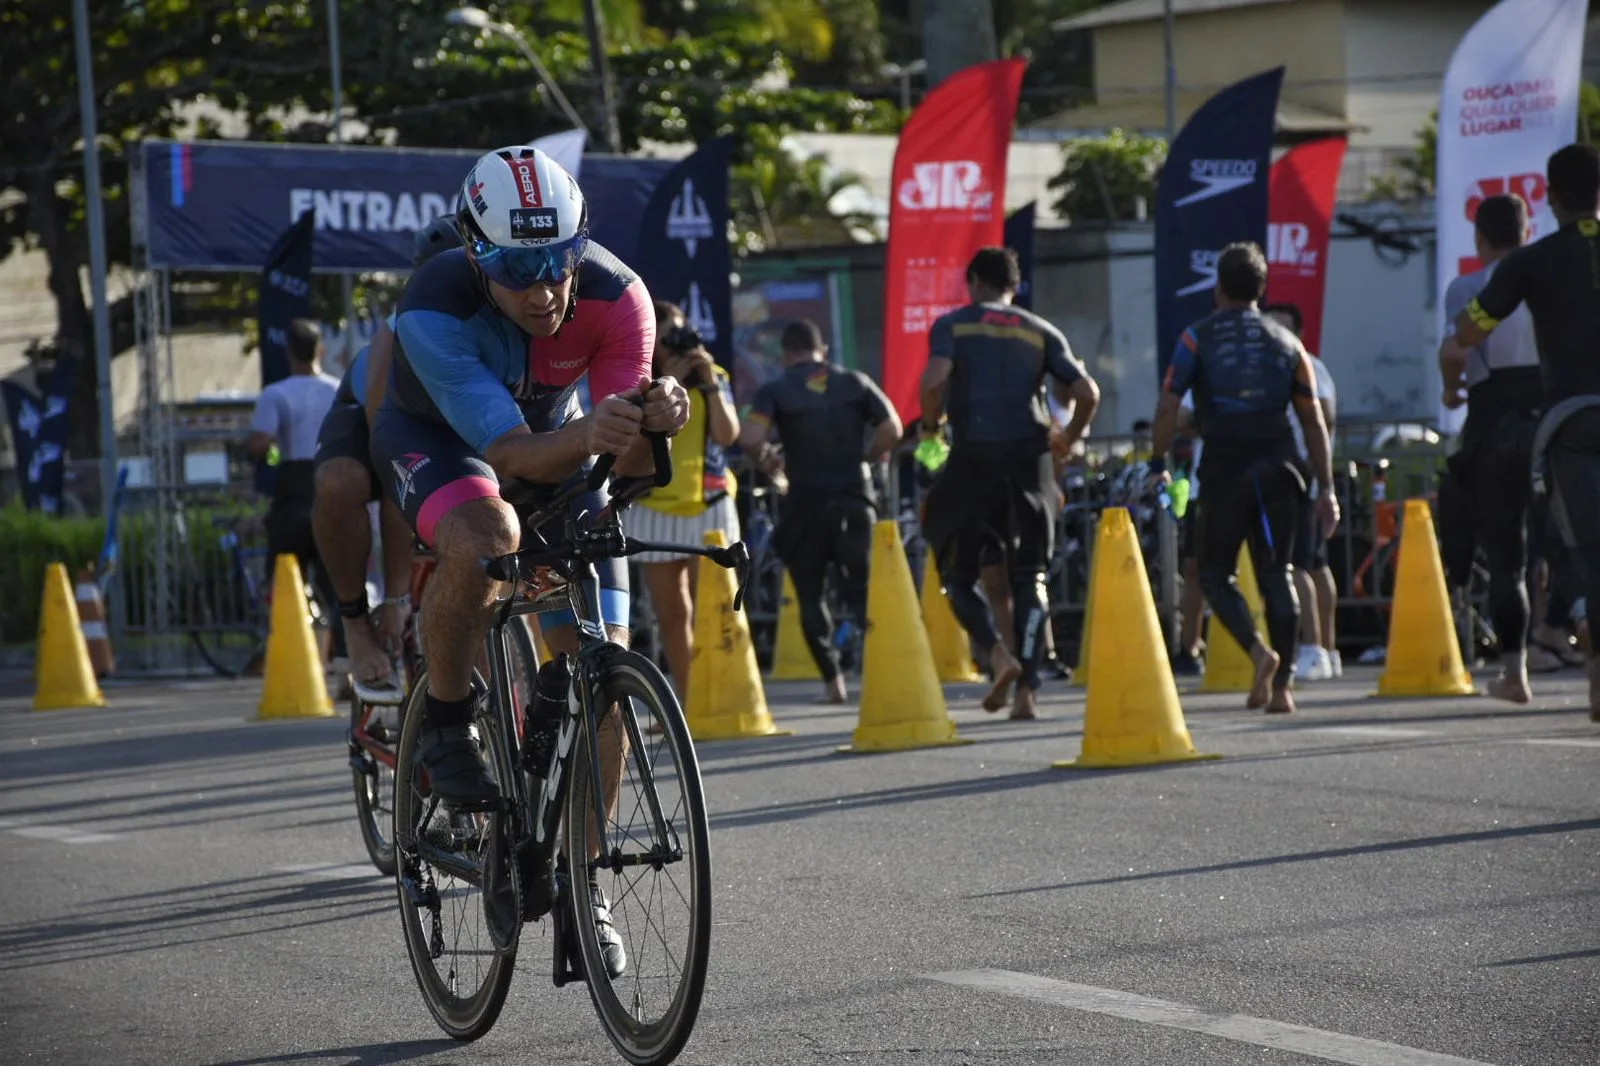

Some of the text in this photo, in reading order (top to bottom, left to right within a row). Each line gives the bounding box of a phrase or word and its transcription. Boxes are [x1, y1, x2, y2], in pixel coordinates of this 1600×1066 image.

[1460, 118, 1522, 137] LUGAR
[518, 165, 538, 205] AERO
[289, 188, 459, 233] ENTRAD
[529, 215, 554, 229] 133
